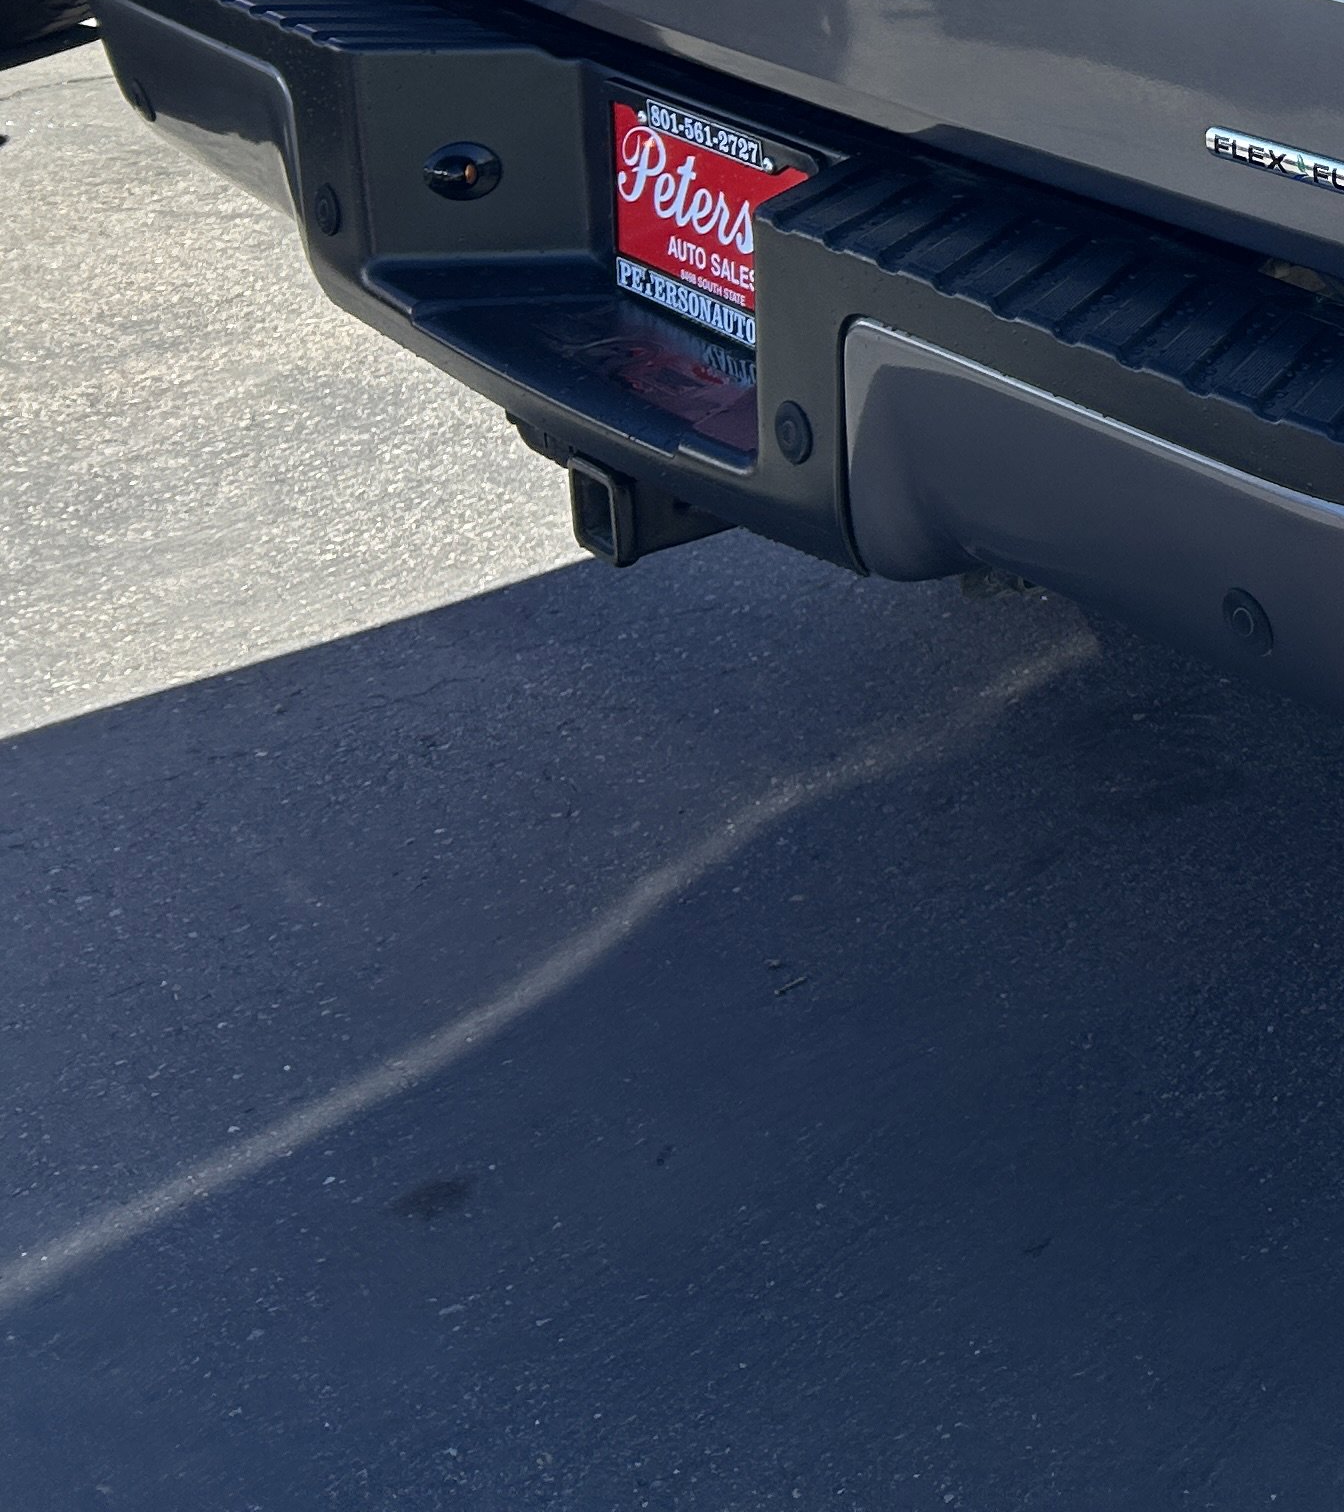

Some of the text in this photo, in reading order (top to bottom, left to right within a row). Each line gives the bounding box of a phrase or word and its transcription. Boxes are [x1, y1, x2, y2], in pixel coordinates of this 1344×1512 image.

[650, 104, 758, 163] 801-561-2727
[1214, 134, 1289, 174] FLEX
[617, 125, 754, 255] Peters
[667, 235, 707, 270] AUTO
[619, 261, 757, 345] PETERSONAUTO
[697, 276, 723, 298] SOUTH
[723, 287, 747, 307] STATE
